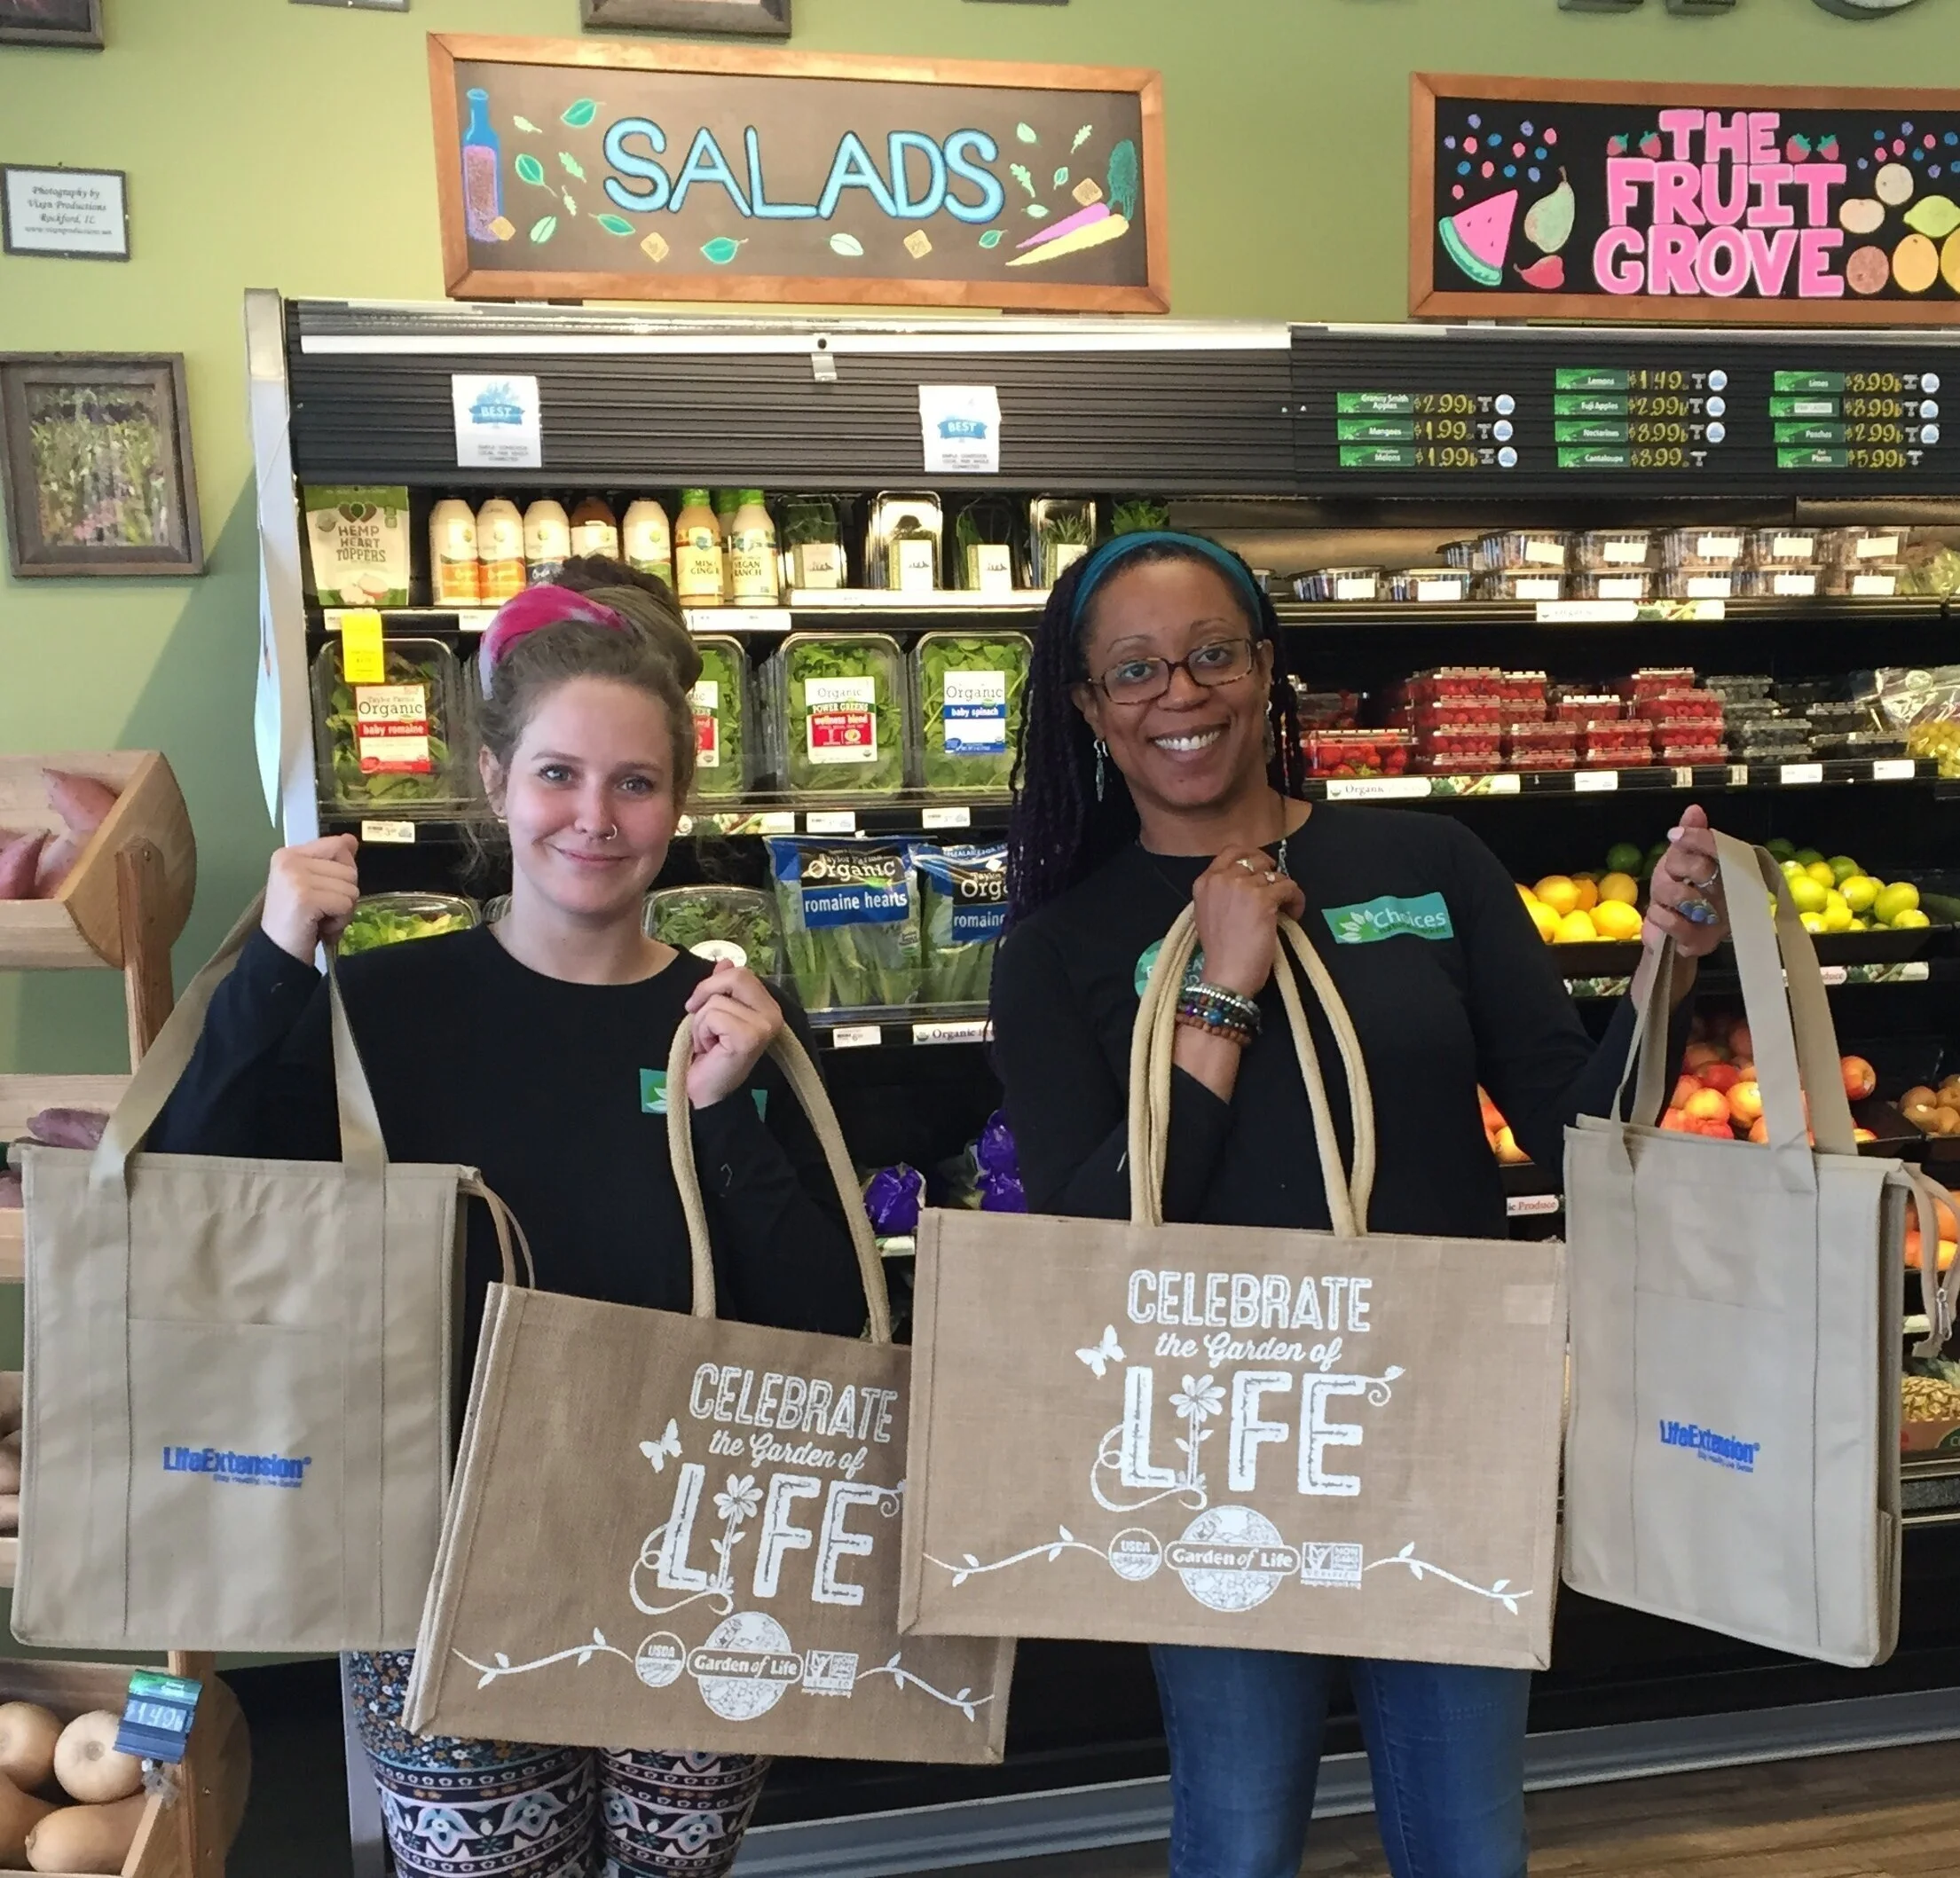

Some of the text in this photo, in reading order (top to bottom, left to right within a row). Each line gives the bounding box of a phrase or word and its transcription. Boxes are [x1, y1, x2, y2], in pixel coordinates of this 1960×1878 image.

[1658, 108, 1781, 165] THE
[603, 116, 1006, 224] SALADS
[32, 185, 87, 199] Photography
[1606, 157, 1847, 228] FRUIT
[1593, 224, 1846, 298] GROVE
[480, 405, 512, 418] BEST
[948, 421, 977, 433] BEST
[338, 525, 380, 538] HEMP
[340, 538, 380, 548] HEART
[336, 548, 386, 562] TOPPERS
[817, 688, 862, 699] Organic
[946, 686, 1003, 703] Organic
[358, 701, 423, 718] Organic
[812, 703, 869, 713] POWER GREENS
[951, 706, 999, 718] baby spinach
[363, 723, 424, 736] baby romaine
[807, 859, 895, 881] Organic
[805, 891, 907, 913] romaine hearts
[1374, 908, 1446, 929] Choices
[932, 1028, 975, 1041] Organic
[1127, 1269, 1373, 1332] CELEBRATE
[1154, 1331, 1343, 1372] the Garden of
[689, 1363, 898, 1443] CELEBRATE
[709, 1429, 869, 1480] the Garden of
[1121, 1539, 1151, 1552] USDA
[1172, 1548, 1234, 1565] Garden
[1236, 1547, 1259, 1570] of
[1260, 1552, 1293, 1568] Life
[648, 1644, 676, 1658] USDA
[694, 1654, 750, 1674] Garden
[750, 1655, 769, 1678] of
[770, 1661, 798, 1676] Life
